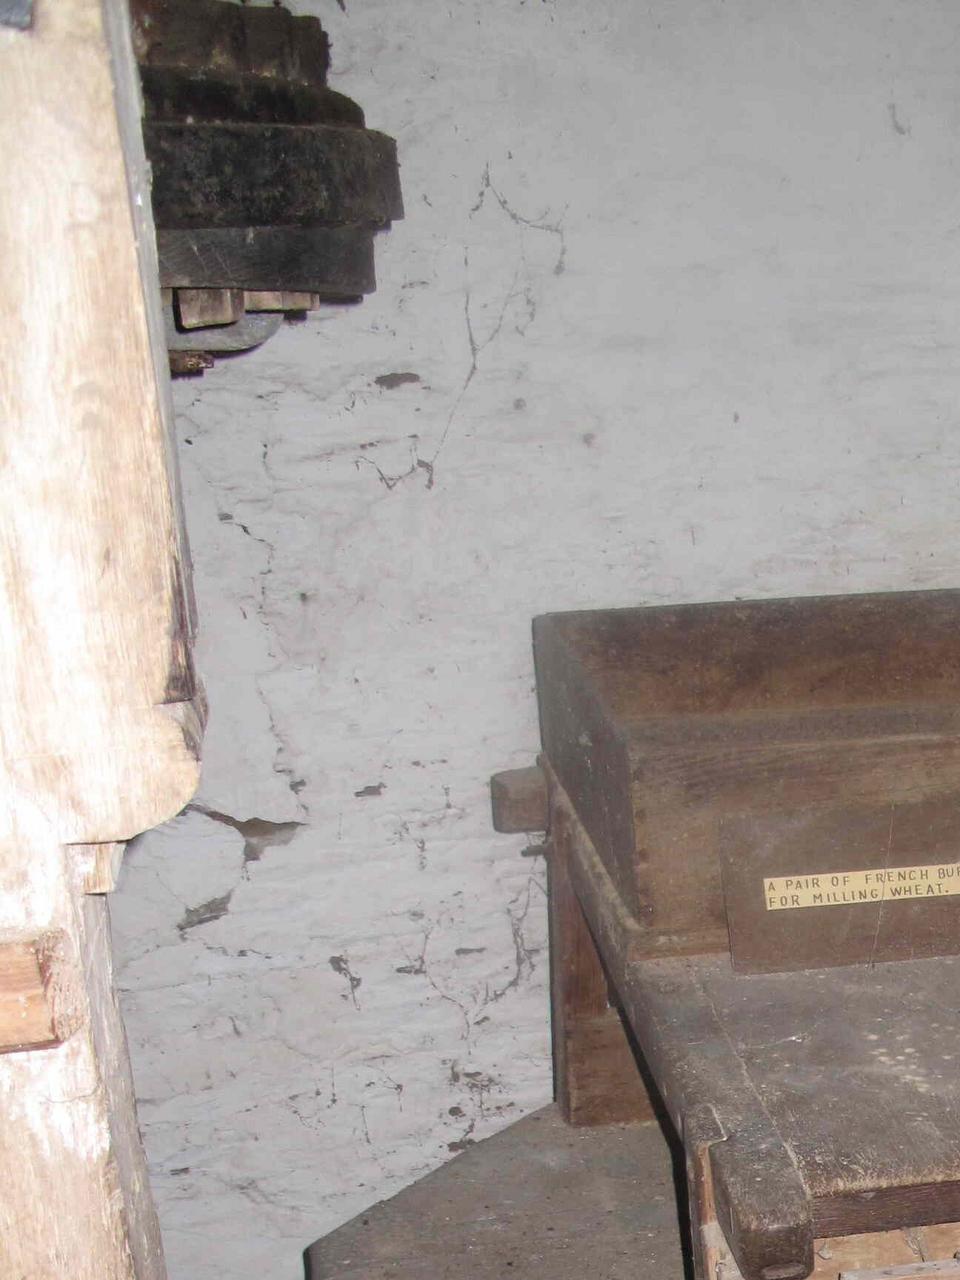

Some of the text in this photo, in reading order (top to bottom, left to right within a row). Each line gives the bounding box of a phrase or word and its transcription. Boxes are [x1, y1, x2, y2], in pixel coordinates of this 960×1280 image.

[768, 882, 776, 892] A
[785, 878, 821, 890] PAIR
[831, 875, 850, 887] OF
[865, 869, 929, 885] FRENCH
[768, 884, 950, 908] FOR MILLING WHEAT.
